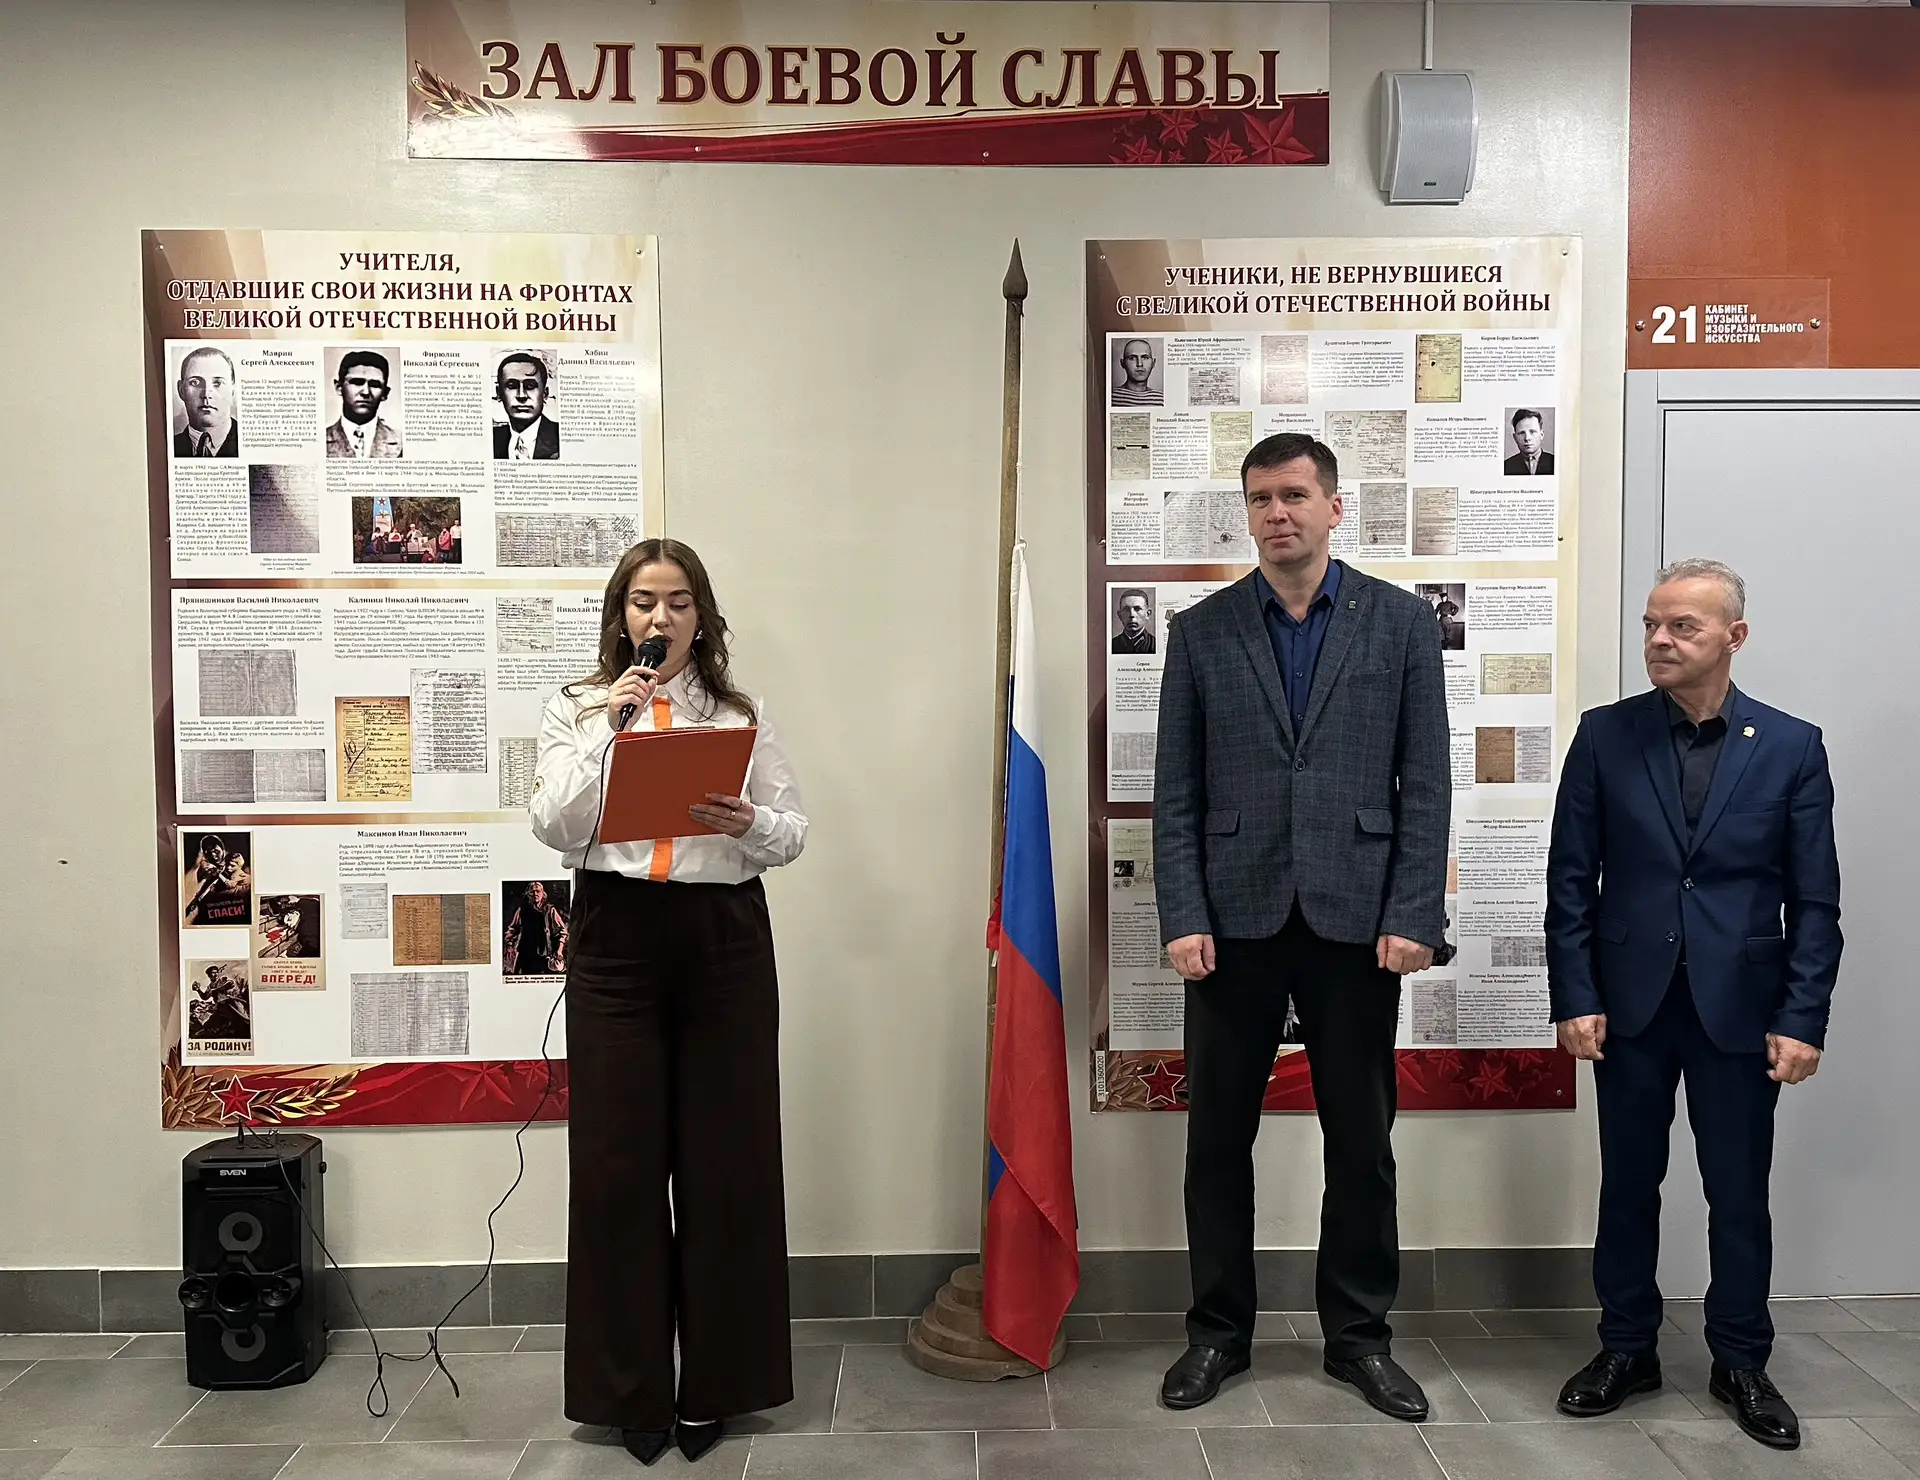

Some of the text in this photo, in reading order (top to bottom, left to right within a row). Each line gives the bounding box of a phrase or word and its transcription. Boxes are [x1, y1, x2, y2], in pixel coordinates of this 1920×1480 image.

[479, 30, 1281, 110] ЗАЛ БОЕВОЙ СЛАВЫ
[339, 252, 460, 274] УЧИТЕЛЯ,
[1166, 266, 1502, 288] УЧЕНИКИ, НЕ ВЕРНУВШИЕСЯ
[166, 280, 633, 303] ОТДАВШИЕ СВОИ ЖИЗНИ НА ФРОНТАХ
[1116, 290, 1550, 315] С ВЕЛИКОЙ ОТЕЧЕСТВЕННОЙ ВОЙНЫ
[1705, 304, 1748, 314] КАБИНЕТ
[184, 306, 616, 332] ВЕЛИКОЙ ОТЕЧЕСТВЕННОЙ ВОЙНЫ
[1705, 314, 1757, 324] МУЗЫКИ И
[1652, 306, 1696, 344] 21
[1705, 324, 1804, 334] ИЗОБРАЗИТЕЛЬНОГО
[1705, 334, 1760, 344] ИСКУССТВА
[240, 359, 268, 367] Сергей
[439, 360, 480, 368] Сергеевич
[208, 905, 246, 918] СПАСИ!
[262, 974, 316, 984] ВПЕРЕД!
[188, 1042, 251, 1051] ЗА РОДИНУ!
